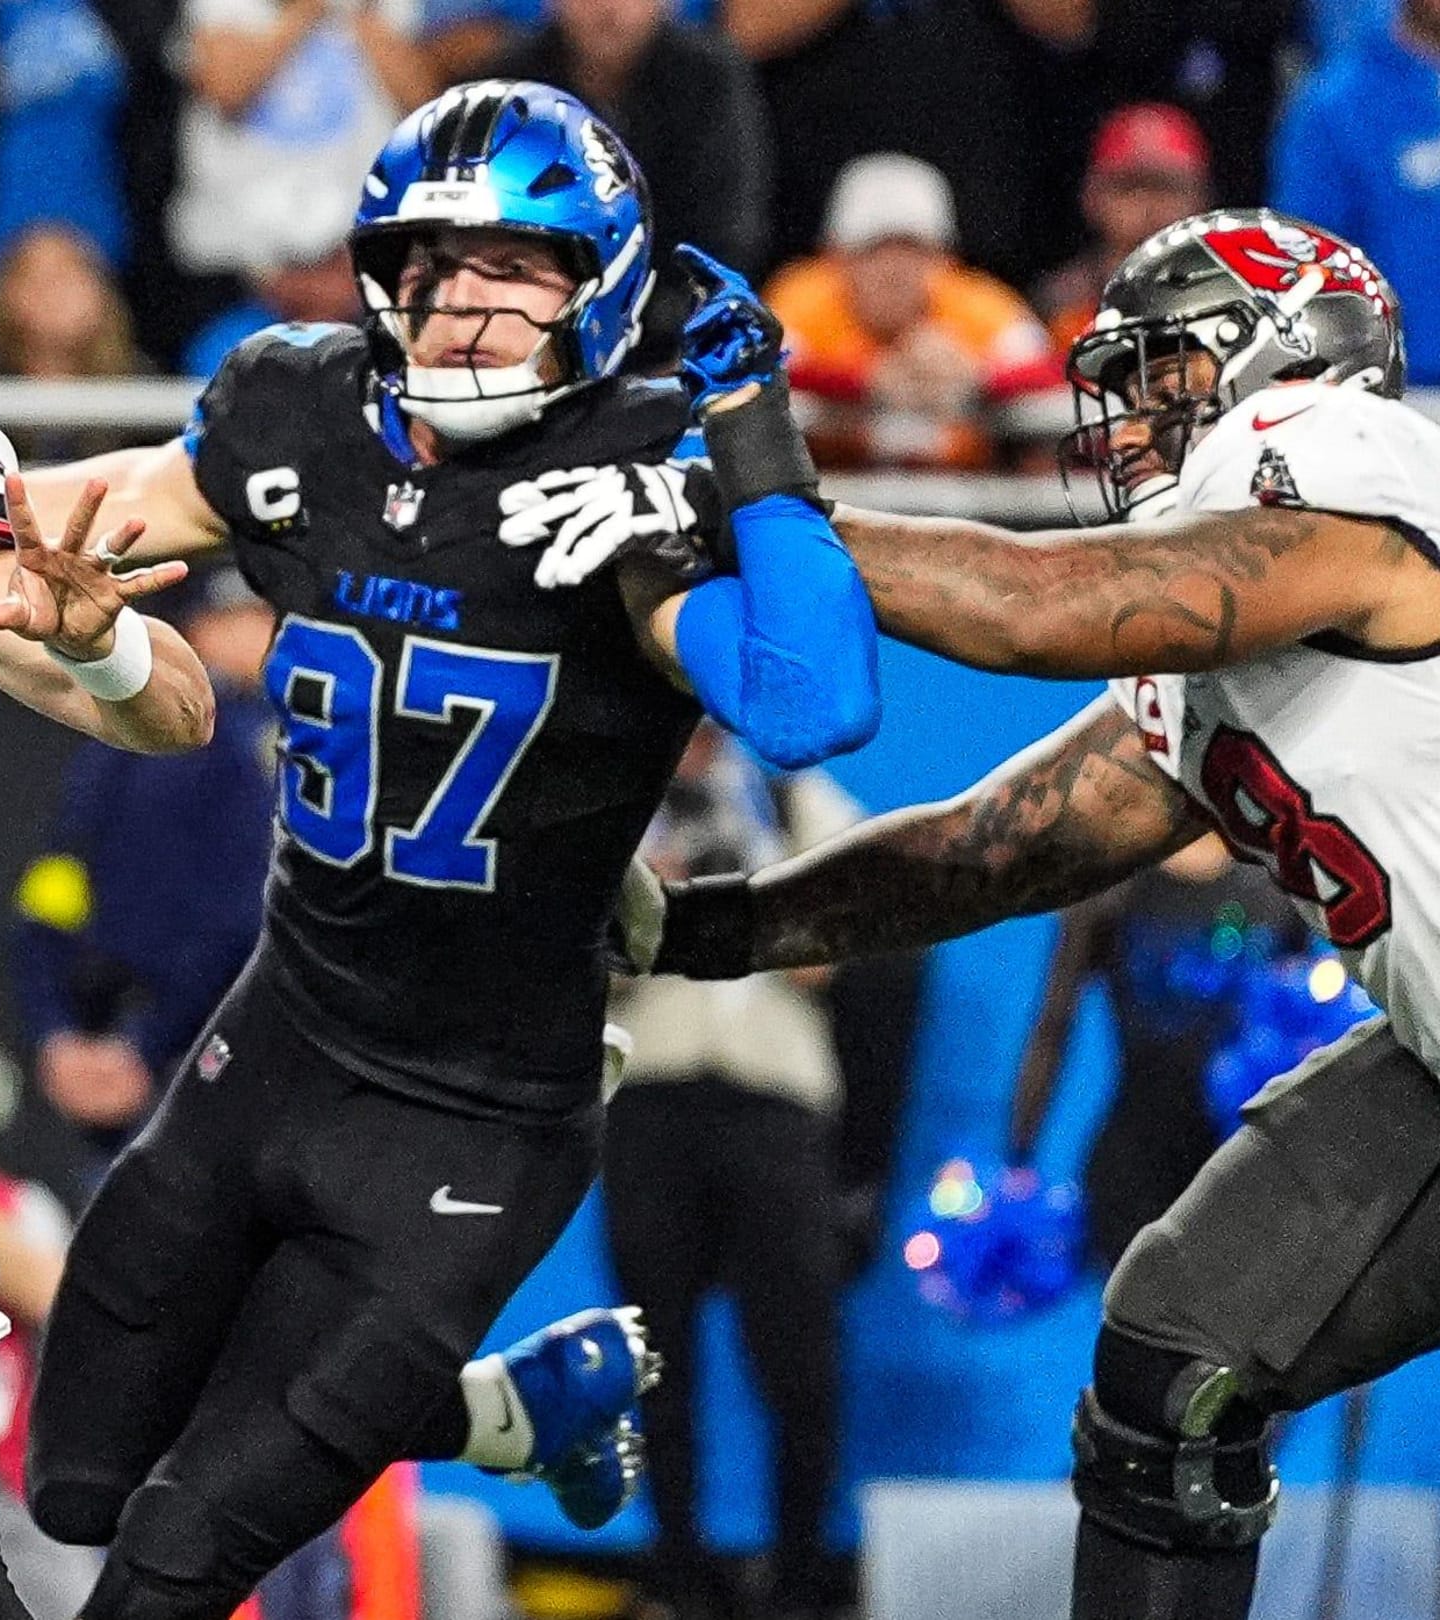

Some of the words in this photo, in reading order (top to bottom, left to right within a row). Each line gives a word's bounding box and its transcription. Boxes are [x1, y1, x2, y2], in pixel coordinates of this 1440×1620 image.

[247, 466, 301, 521] C
[335, 569, 461, 631] LIONS
[264, 612, 560, 892] 97
